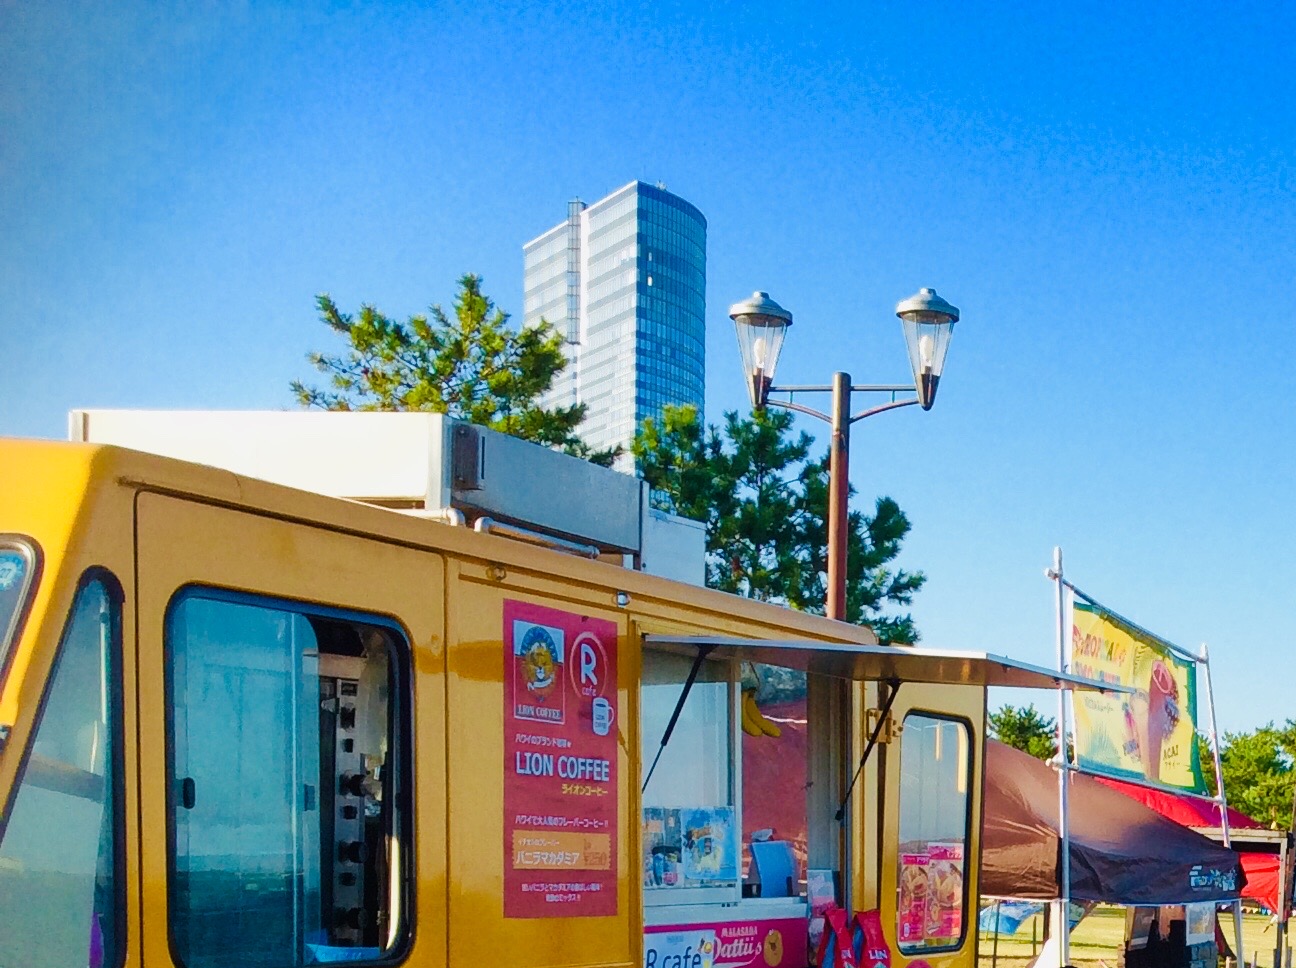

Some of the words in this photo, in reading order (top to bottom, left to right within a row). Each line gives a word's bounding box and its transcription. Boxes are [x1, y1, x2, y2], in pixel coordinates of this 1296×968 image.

[580, 643, 598, 686] R
[517, 703, 535, 716] LION
[536, 706, 561, 719] COFFEE
[516, 751, 554, 776] LION
[557, 755, 610, 782] COFFEE
[561, 783, 609, 797] ライオンコーヒー
[516, 851, 580, 866] バニラマカダミア
[721, 925, 758, 938] MALASADA
